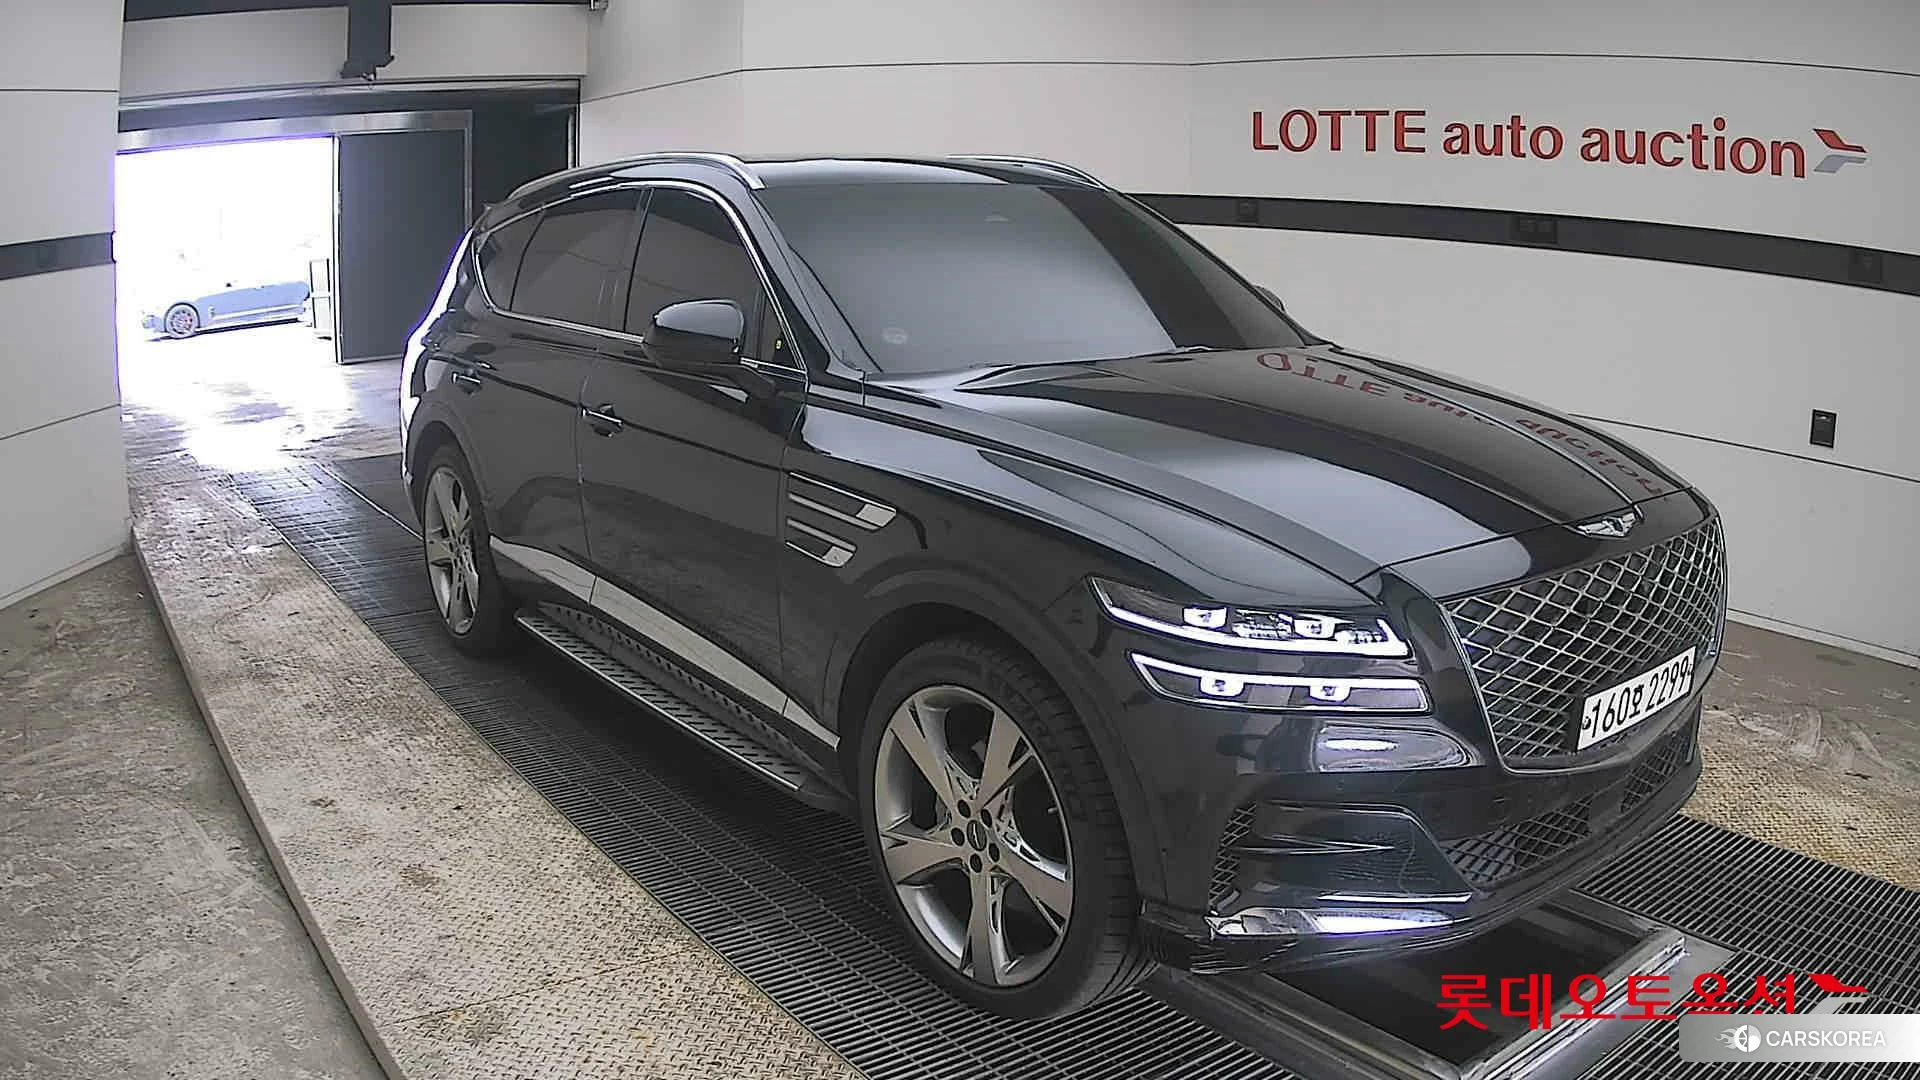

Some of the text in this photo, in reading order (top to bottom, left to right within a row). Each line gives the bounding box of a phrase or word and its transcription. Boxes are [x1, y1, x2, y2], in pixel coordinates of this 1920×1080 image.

[1252, 109, 1807, 179] LOTTE auto auction
[1591, 655, 1690, 739] 160호 2299
